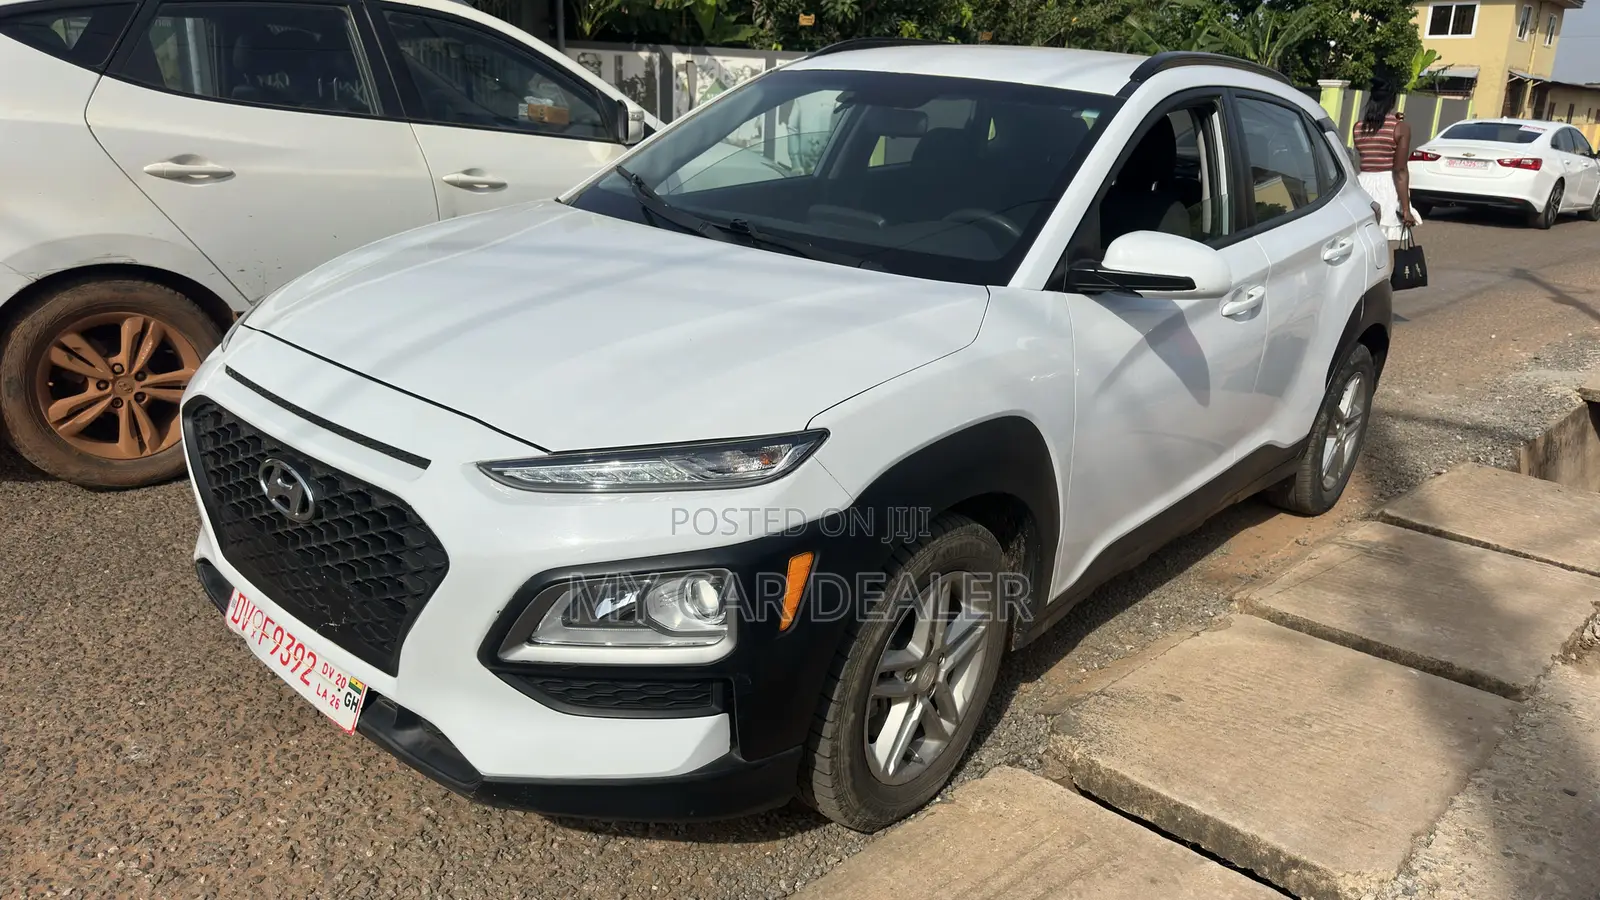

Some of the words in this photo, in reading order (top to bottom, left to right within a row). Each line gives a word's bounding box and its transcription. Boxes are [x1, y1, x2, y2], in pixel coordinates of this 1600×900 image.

[321, 661, 335, 680] DV
[335, 672, 347, 690] 20
[316, 683, 328, 700] LA
[329, 693, 341, 711] 26
[344, 691, 360, 714] GH
